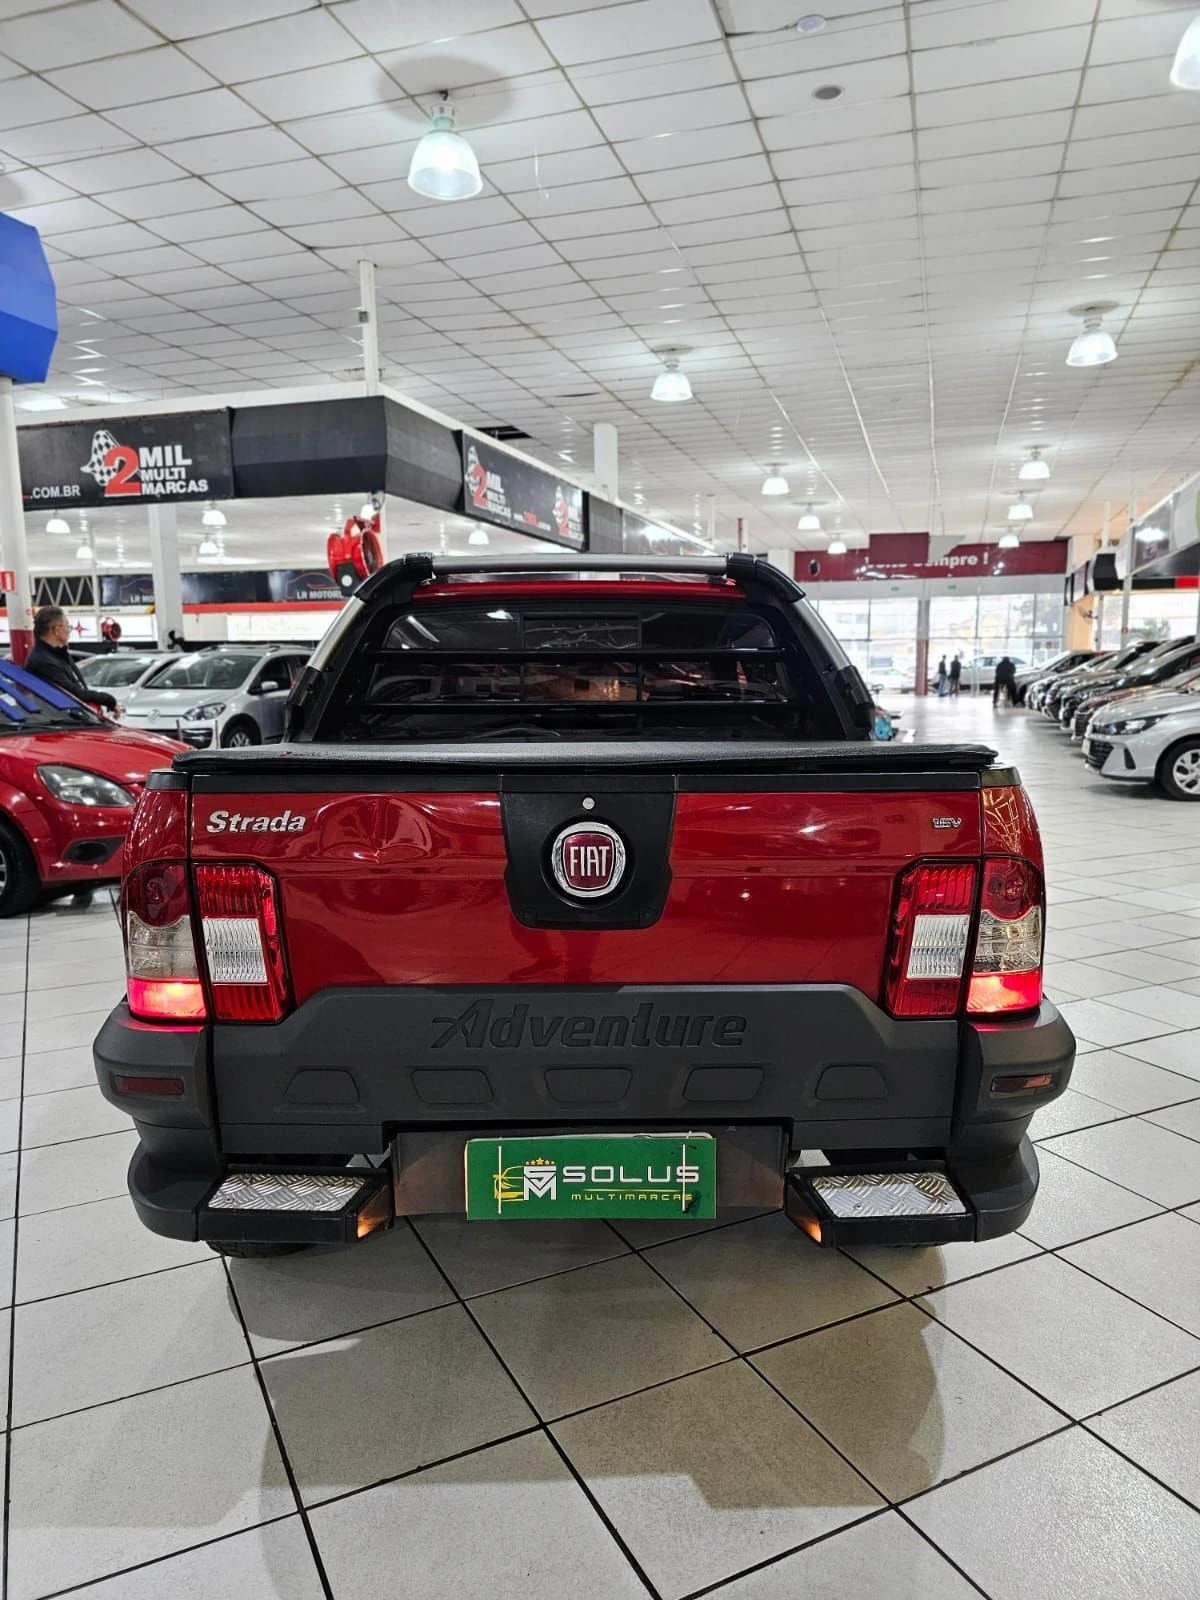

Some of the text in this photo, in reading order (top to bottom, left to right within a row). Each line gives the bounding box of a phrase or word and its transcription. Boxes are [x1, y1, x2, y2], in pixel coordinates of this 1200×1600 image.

[104, 446, 192, 497] 2 MIL
[140, 467, 187, 481] MULTI
[23, 485, 81, 500] .COM.BR
[141, 479, 209, 496] MARCAS
[472, 464, 488, 509] 2
[296, 591, 308, 600] LR
[206, 810, 306, 833] Strada
[569, 845, 610, 877] FIAT
[430, 998, 748, 1049] Adventure
[562, 1165, 700, 1183] SOLUS
[571, 1193, 693, 1202] MULTIMARCAS
